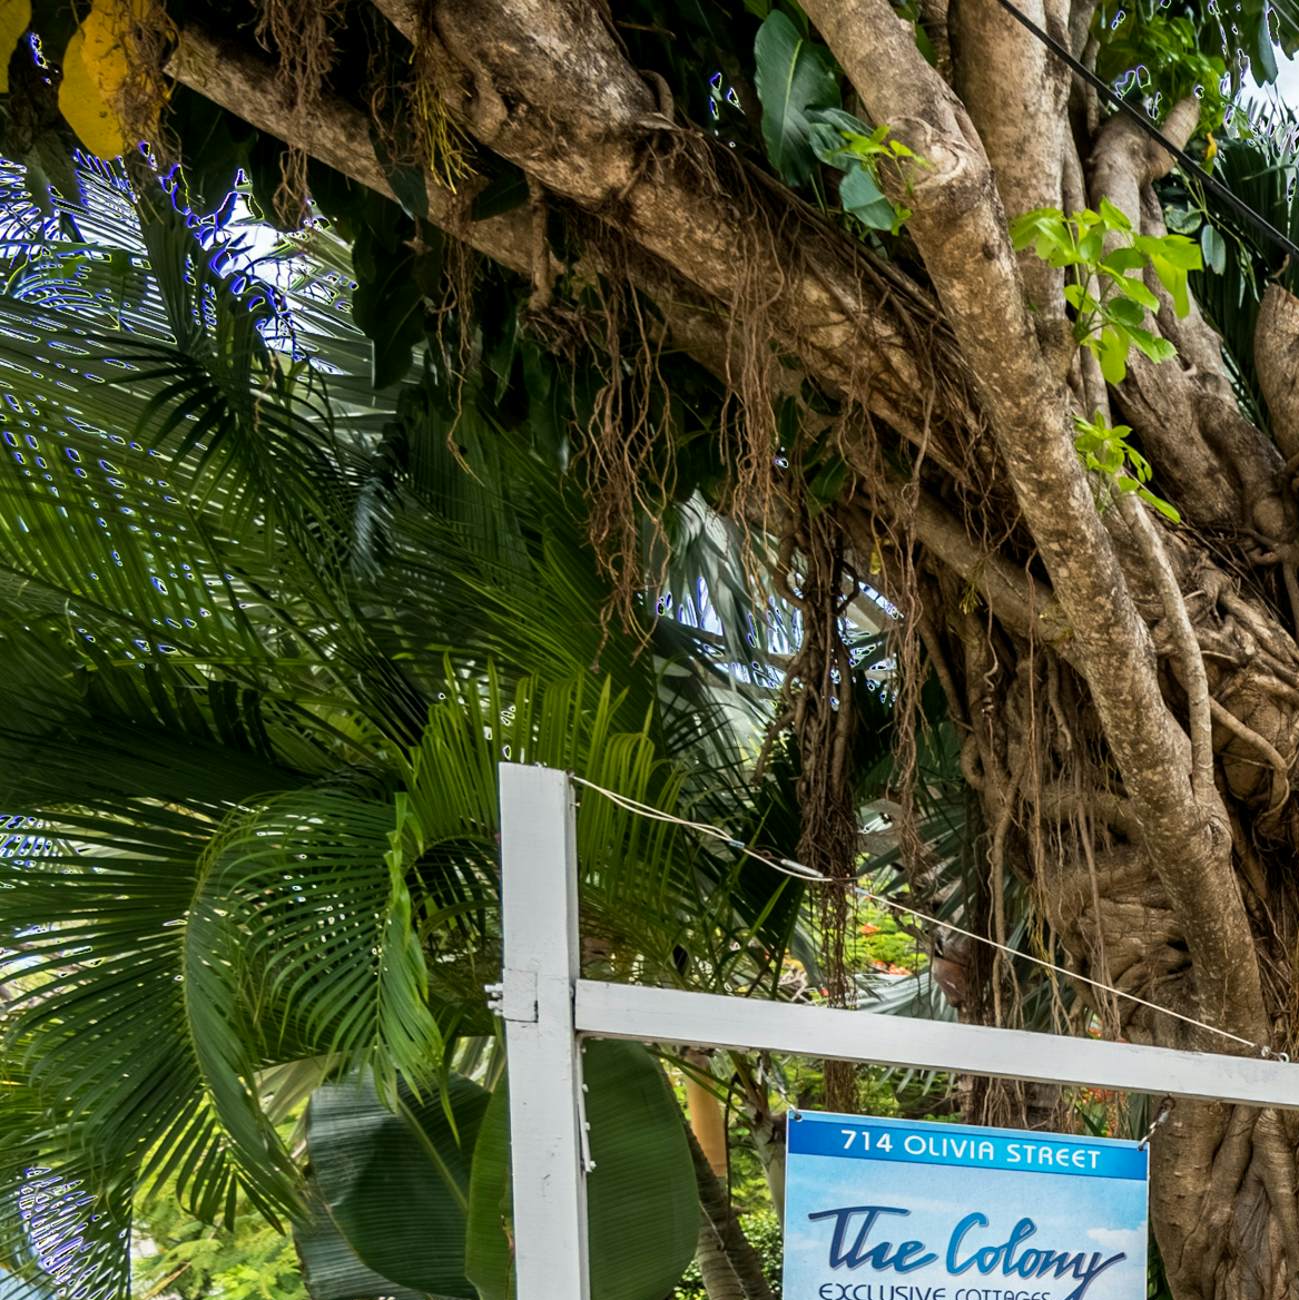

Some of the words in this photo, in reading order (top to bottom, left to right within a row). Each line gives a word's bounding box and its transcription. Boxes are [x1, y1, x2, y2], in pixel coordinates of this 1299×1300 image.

[840, 1129, 894, 1153] 714
[903, 1134, 995, 1162] OLIVIA
[1006, 1143, 1101, 1170] STREET
[808, 1205, 939, 1274] The
